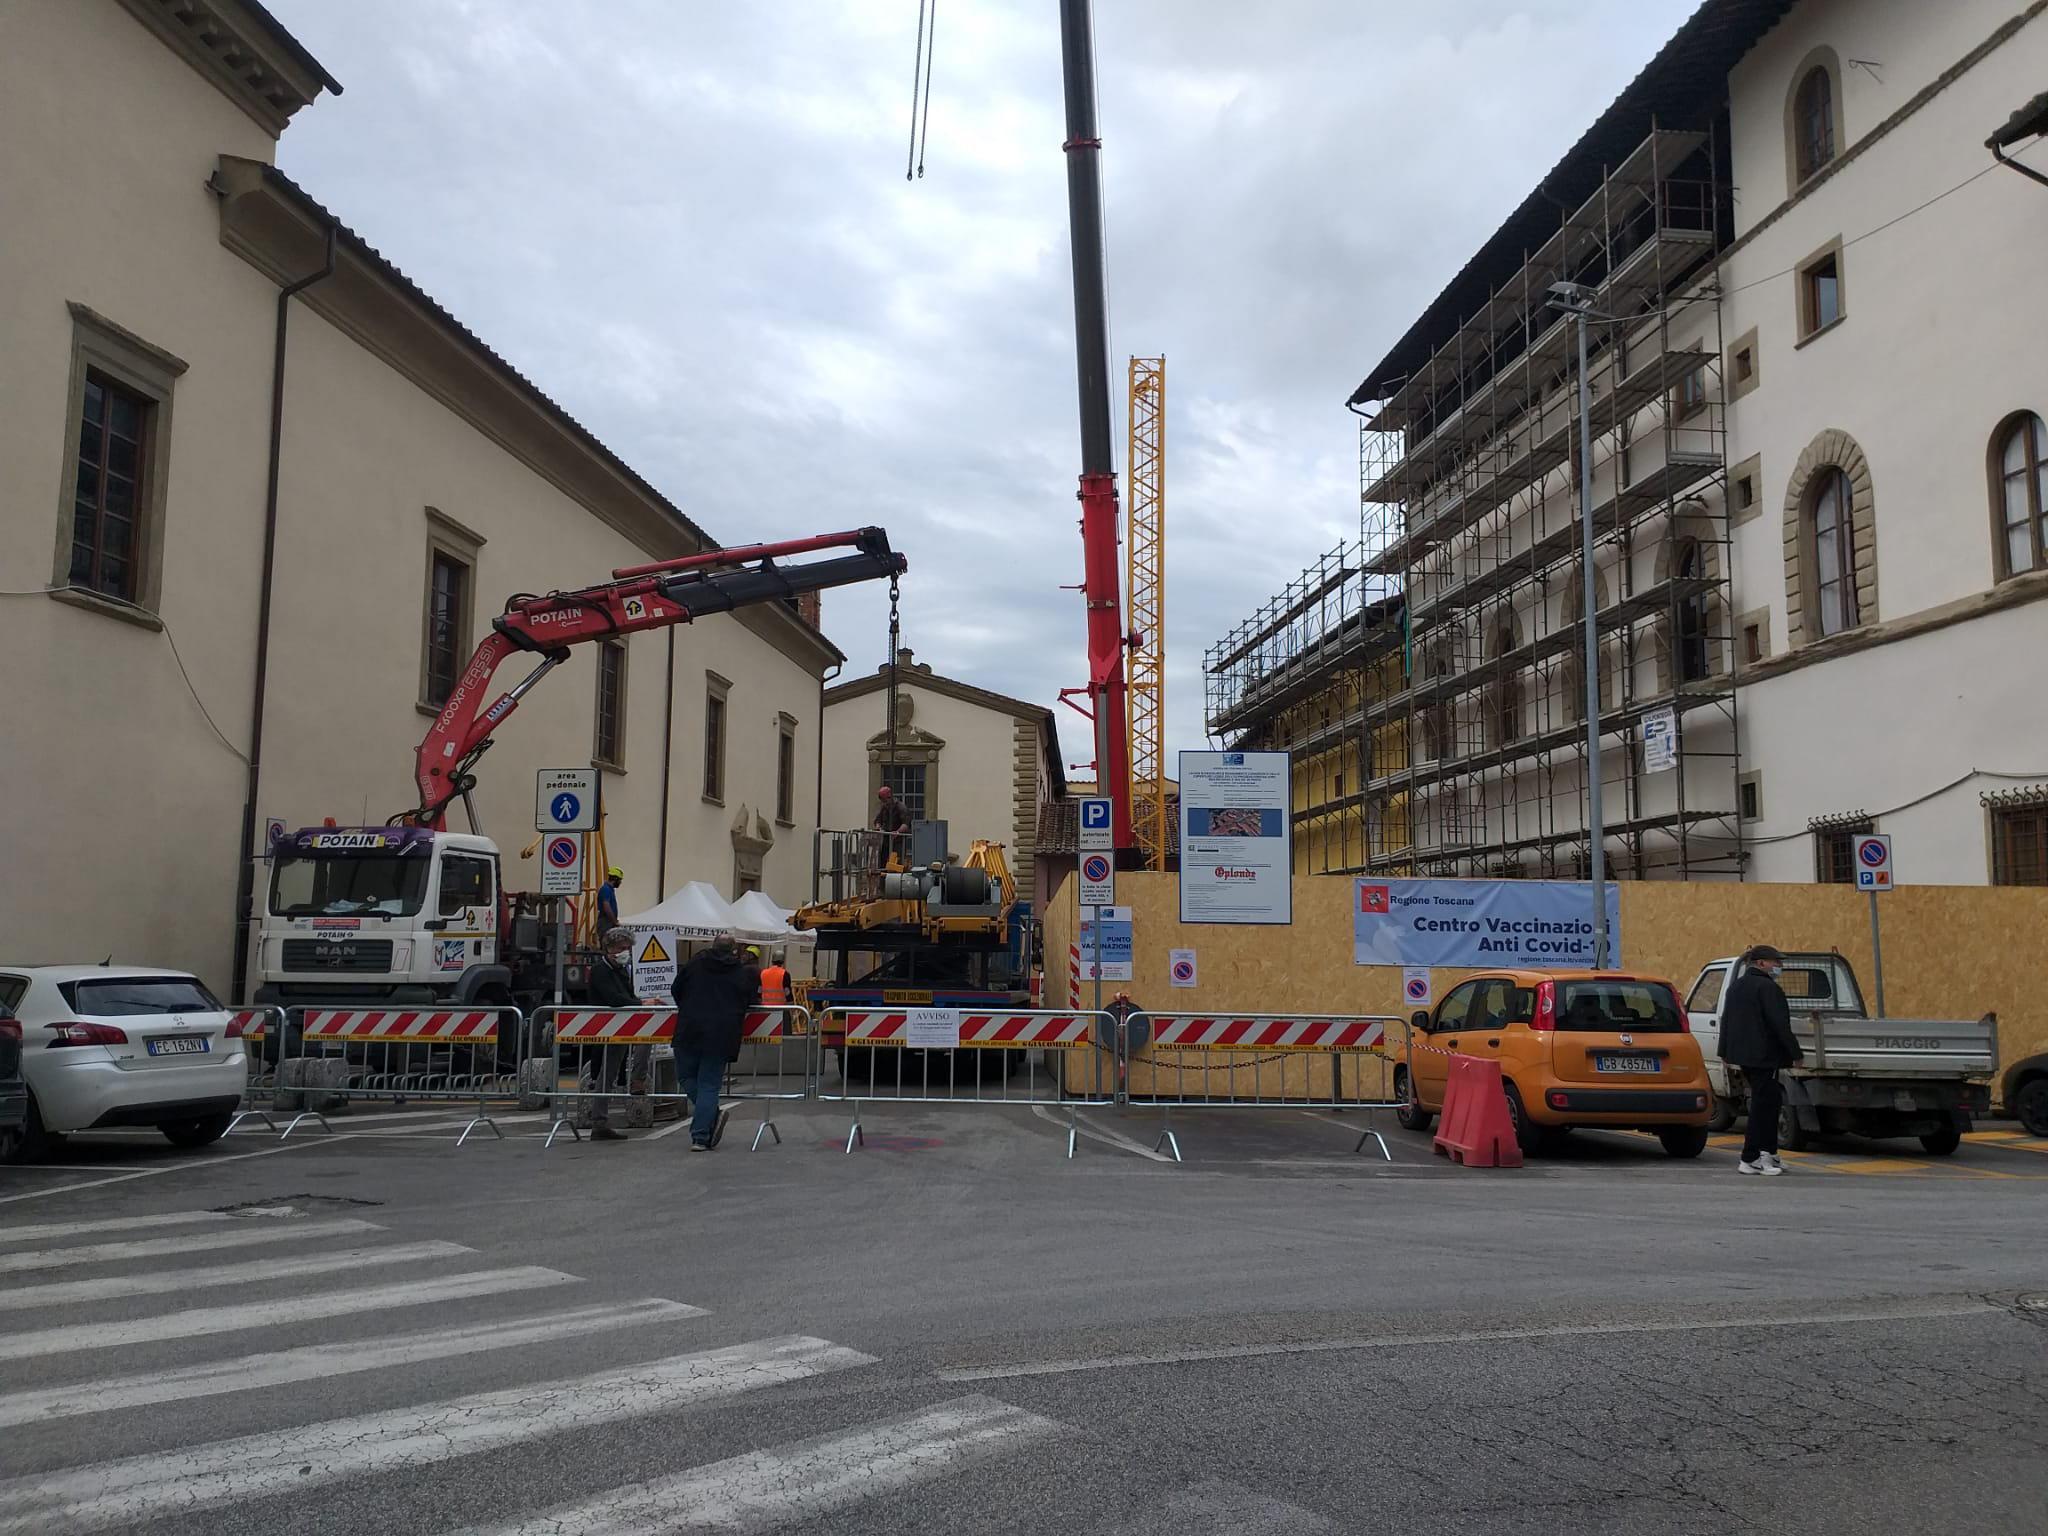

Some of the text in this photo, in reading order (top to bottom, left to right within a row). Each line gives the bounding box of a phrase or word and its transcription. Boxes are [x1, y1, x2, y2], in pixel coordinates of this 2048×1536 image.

[530, 608, 583, 626] POTAIN
[465, 647, 494, 688] FASSI
[435, 687, 466, 734] F600XP
[546, 781, 587, 789] pedonale
[1088, 804, 1105, 825] P
[320, 835, 377, 846] POTAIN
[1390, 895, 1475, 906] Regione Toscana
[1413, 916, 1610, 935] Centro Vaccinazioi
[1477, 936, 1519, 952] Anti
[315, 946, 357, 955] MAN
[635, 965, 675, 975] ATTENZIONE
[644, 975, 666, 983] USCITA
[639, 983, 672, 992] AUTOMEZZ
[915, 1012, 950, 1020] AVVISO
[156, 1041, 170, 1053] FC
[1874, 1037, 1941, 1049] PIAGGIO
